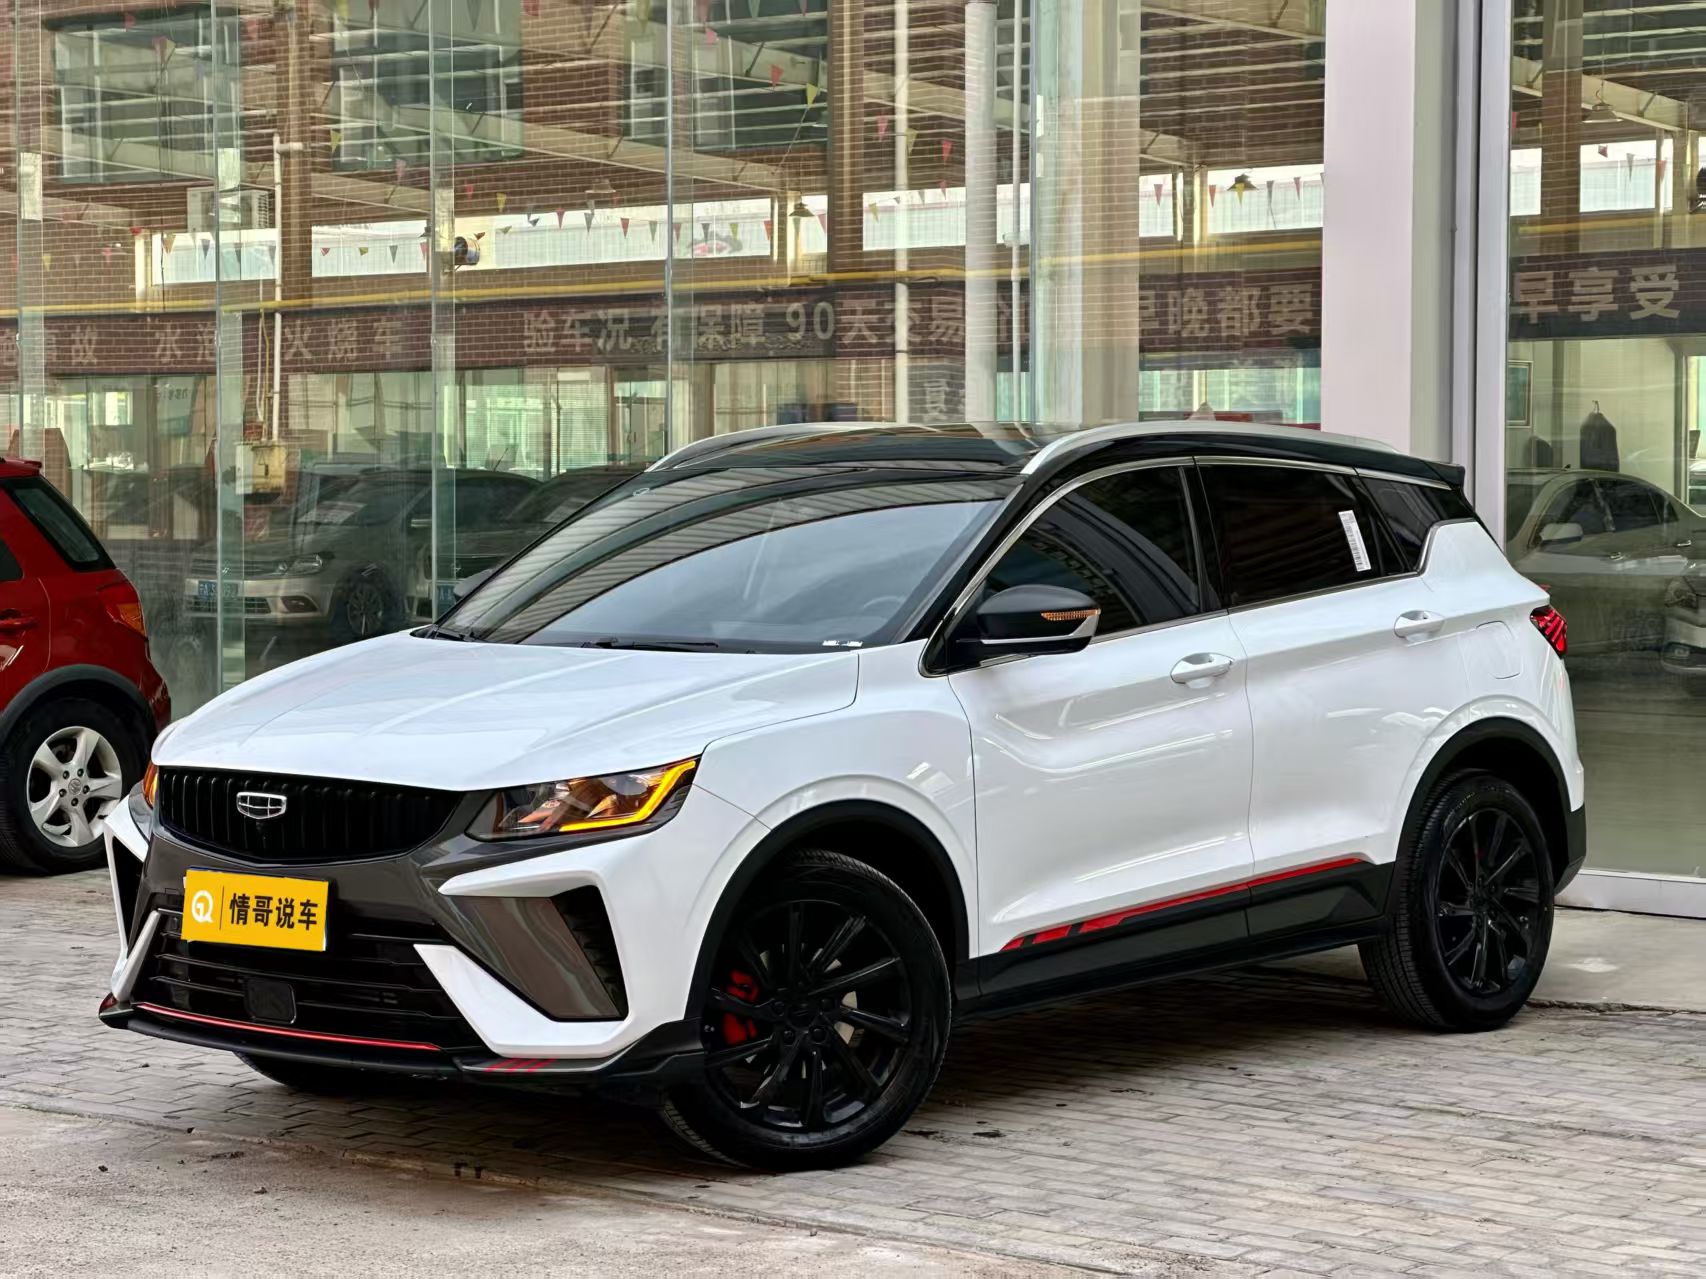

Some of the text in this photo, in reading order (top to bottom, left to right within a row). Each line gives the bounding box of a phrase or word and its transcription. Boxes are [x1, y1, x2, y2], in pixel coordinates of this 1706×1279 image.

[1511, 265, 1681, 324] 早享受
[524, 309, 632, 352] 验车况
